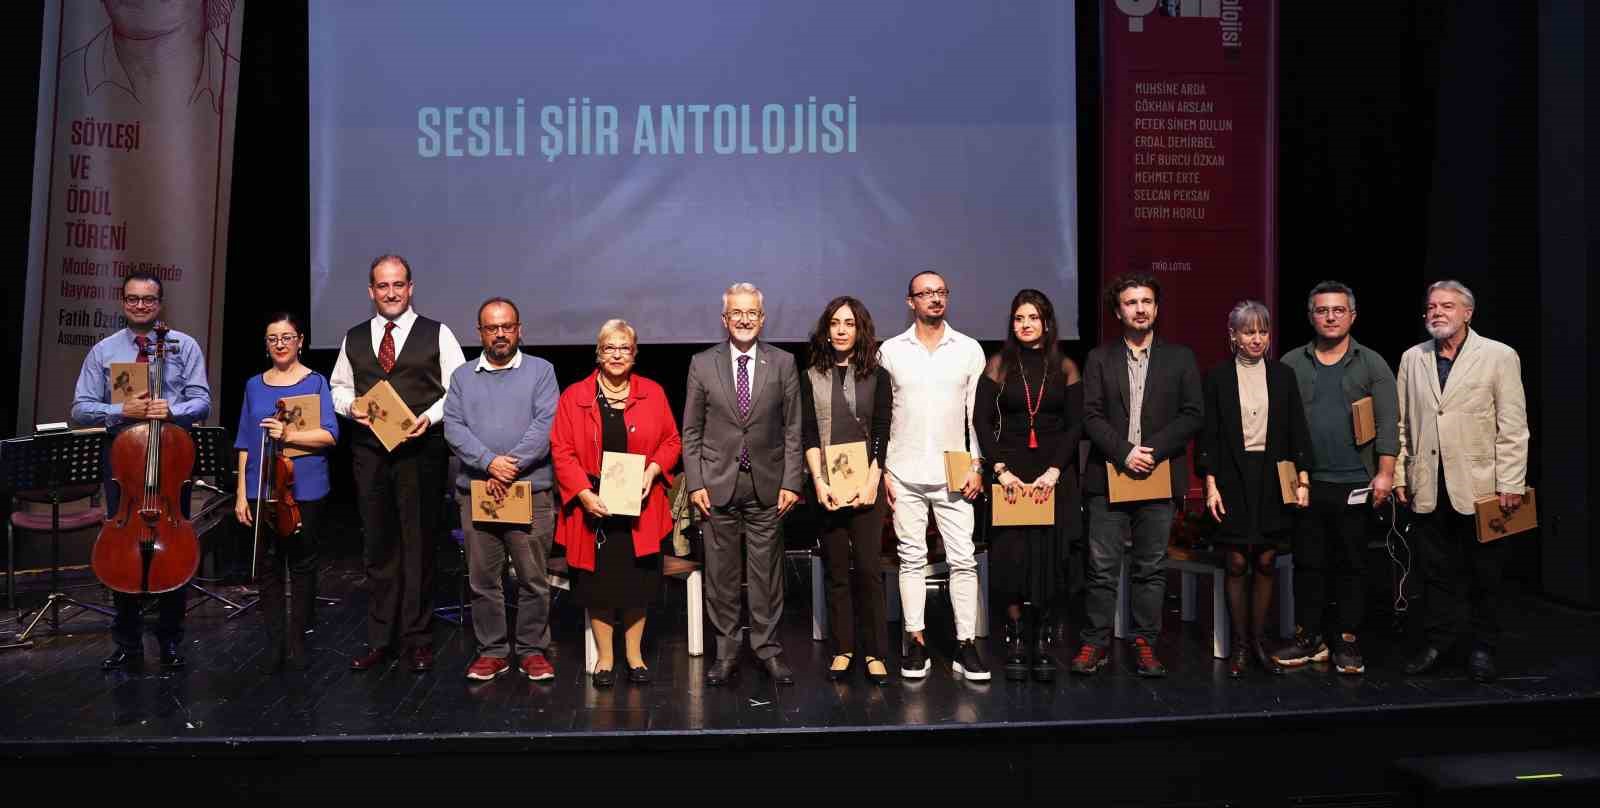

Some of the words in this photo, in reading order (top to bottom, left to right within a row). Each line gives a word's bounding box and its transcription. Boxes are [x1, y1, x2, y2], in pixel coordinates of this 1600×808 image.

[1135, 80, 1180, 96] MUHSİNE
[1180, 82, 1206, 96] ARDA
[1135, 99, 1175, 113] GÖKHAN
[1177, 101, 1214, 113] ARSLAN
[417, 97, 526, 158] SESLİ
[540, 97, 620, 162] ŞİİR
[632, 95, 858, 156] ANTOLOJİSİ
[1135, 117, 1166, 131] PETEK
[1167, 116, 1198, 131] SİNEM
[1200, 119, 1233, 132] DULUN
[71, 117, 141, 152] SÖYLEŞİ
[1135, 136, 1166, 148] ERDAL
[69, 154, 91, 180] VE
[1158, 154, 1191, 166] BURCU
[1193, 153, 1225, 167] ÖZKAN
[1135, 171, 1174, 184] MEHMET
[1176, 172, 1201, 184] ERTE
[66, 185, 112, 217] ÖDÜL
[1134, 189, 1171, 201] SELCAN
[1134, 206, 1170, 219] DEVRİM
[1172, 207, 1205, 220] HORLU
[65, 219, 127, 252] TÖRENİ
[62, 256, 109, 277] Modern
[61, 279, 106, 301] Hayvan
[58, 308, 91, 327] Fatih
